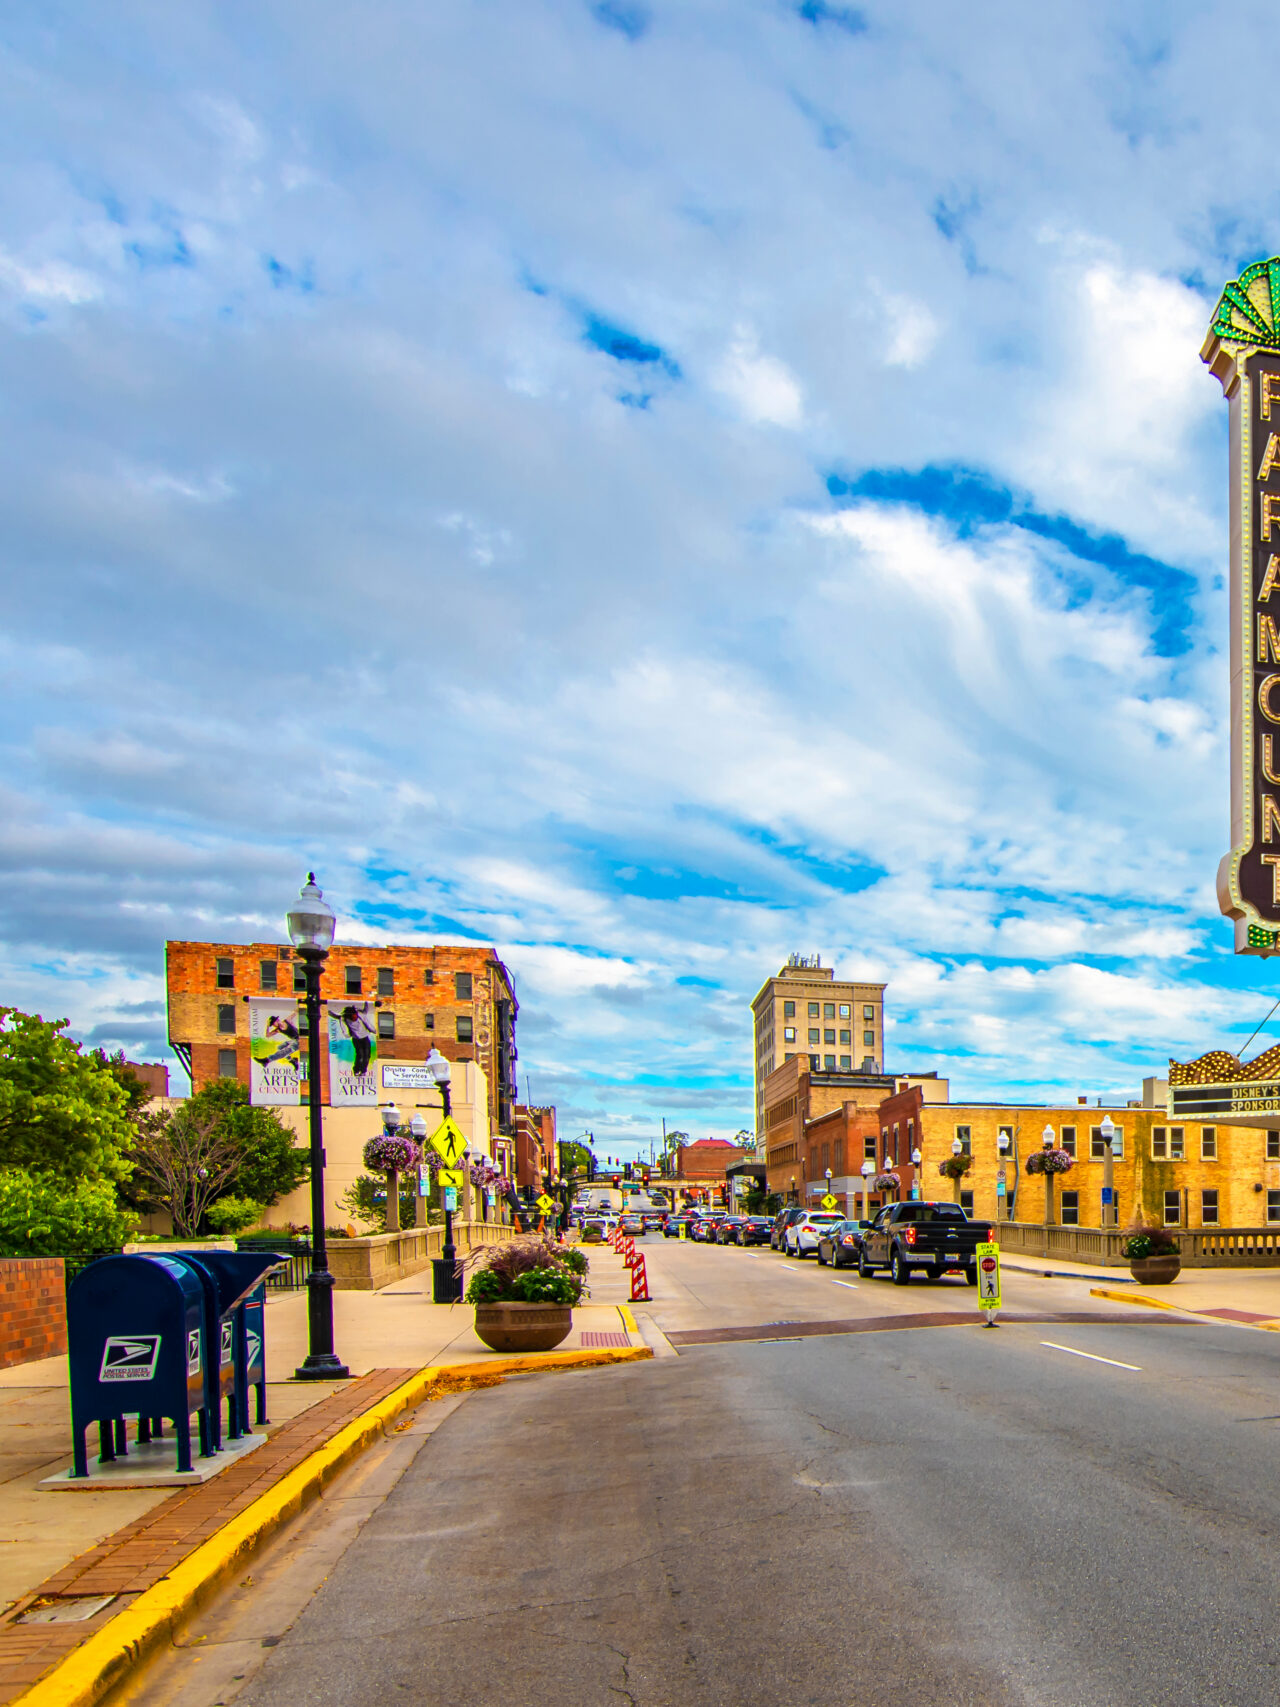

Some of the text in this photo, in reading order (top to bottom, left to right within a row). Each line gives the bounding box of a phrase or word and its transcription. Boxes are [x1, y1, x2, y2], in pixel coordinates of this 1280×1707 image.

[262, 1068, 298, 1076] AURORA
[261, 1075, 299, 1087] ARTS
[339, 1077, 373, 1085] OF THE
[258, 1087, 298, 1095] CENTER
[339, 1085, 377, 1096] ARTS
[1232, 1086, 1279, 1099] DISNEY'S
